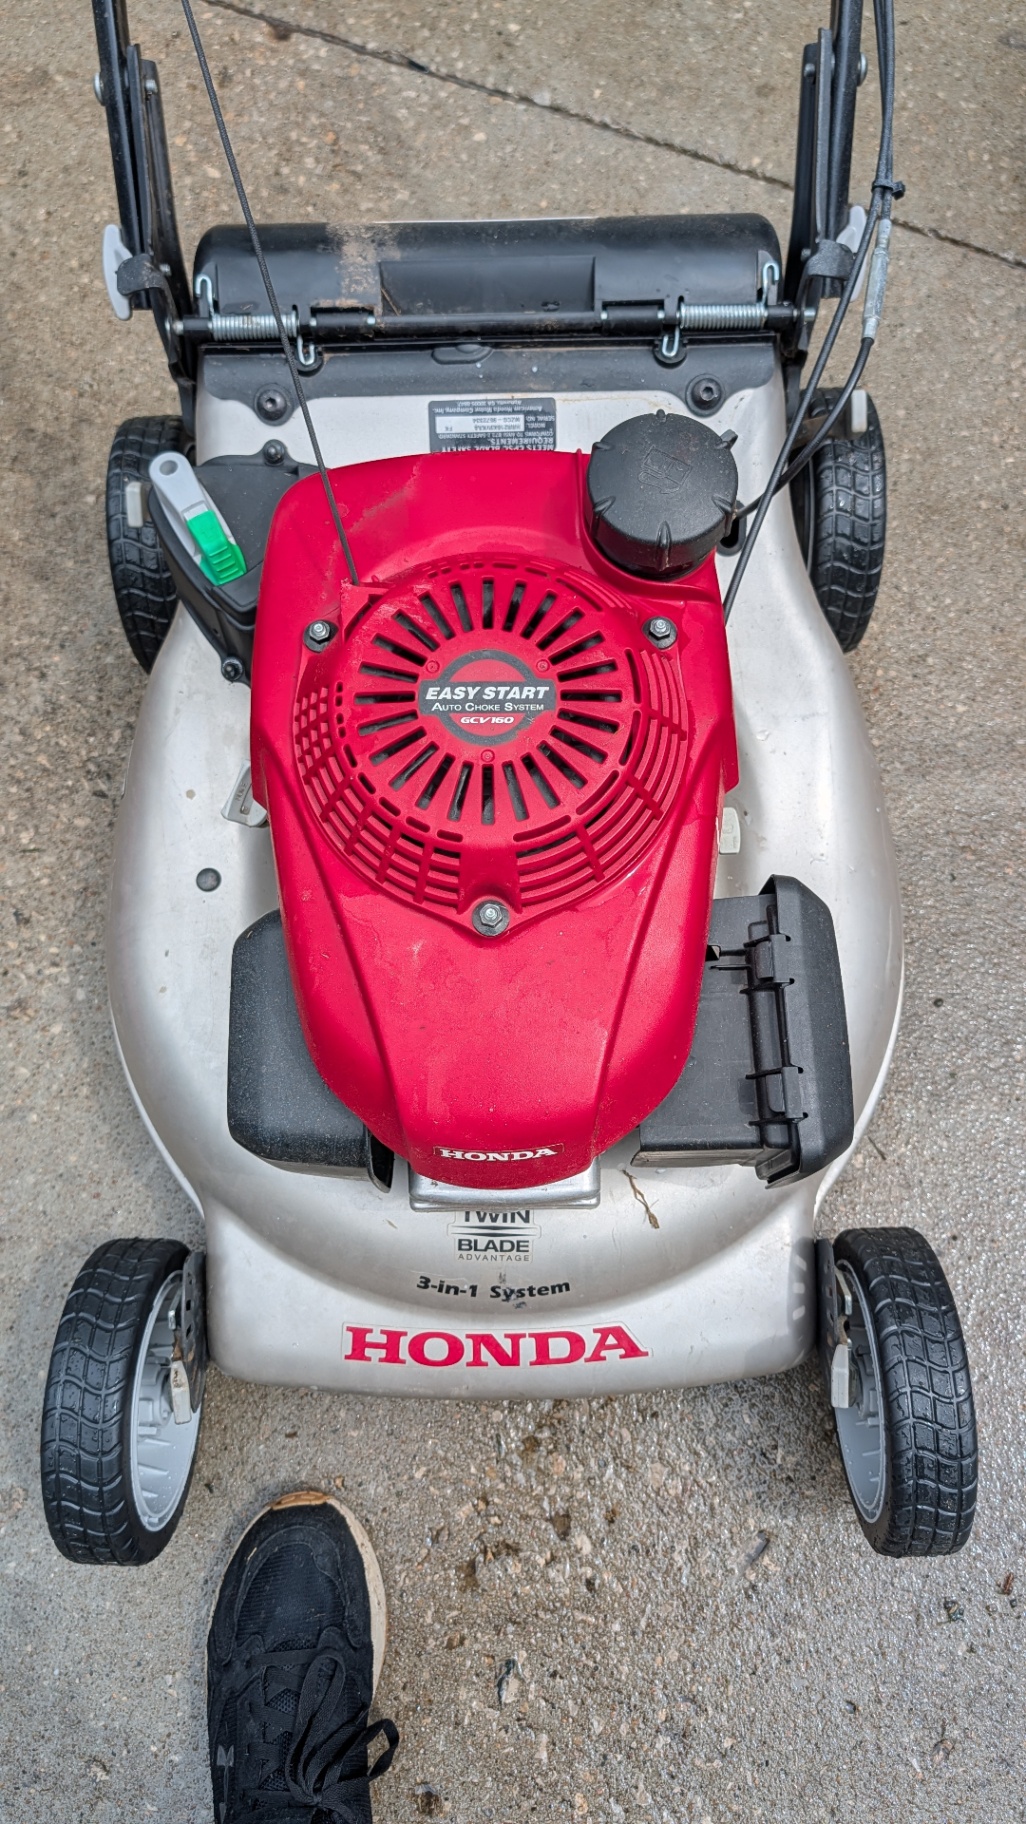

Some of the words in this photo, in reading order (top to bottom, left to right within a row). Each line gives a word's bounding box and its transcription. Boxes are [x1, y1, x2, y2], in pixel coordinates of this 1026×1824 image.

[487, 437, 554, 445] REQUIREMENTS.
[425, 686, 481, 700] EASY
[482, 686, 550, 700] START
[431, 702, 462, 711] AUTO
[465, 702, 500, 711] CHOKE
[504, 702, 544, 711] SYSTEM
[439, 1147, 558, 1162] HONDA
[464, 1209, 530, 1224] TWIN
[457, 1238, 530, 1253] BLADE
[457, 1253, 530, 1262] ADVANTAGE
[416, 1275, 478, 1298] 3-in-1
[489, 1281, 571, 1303] System
[343, 1325, 649, 1367] HONDA
